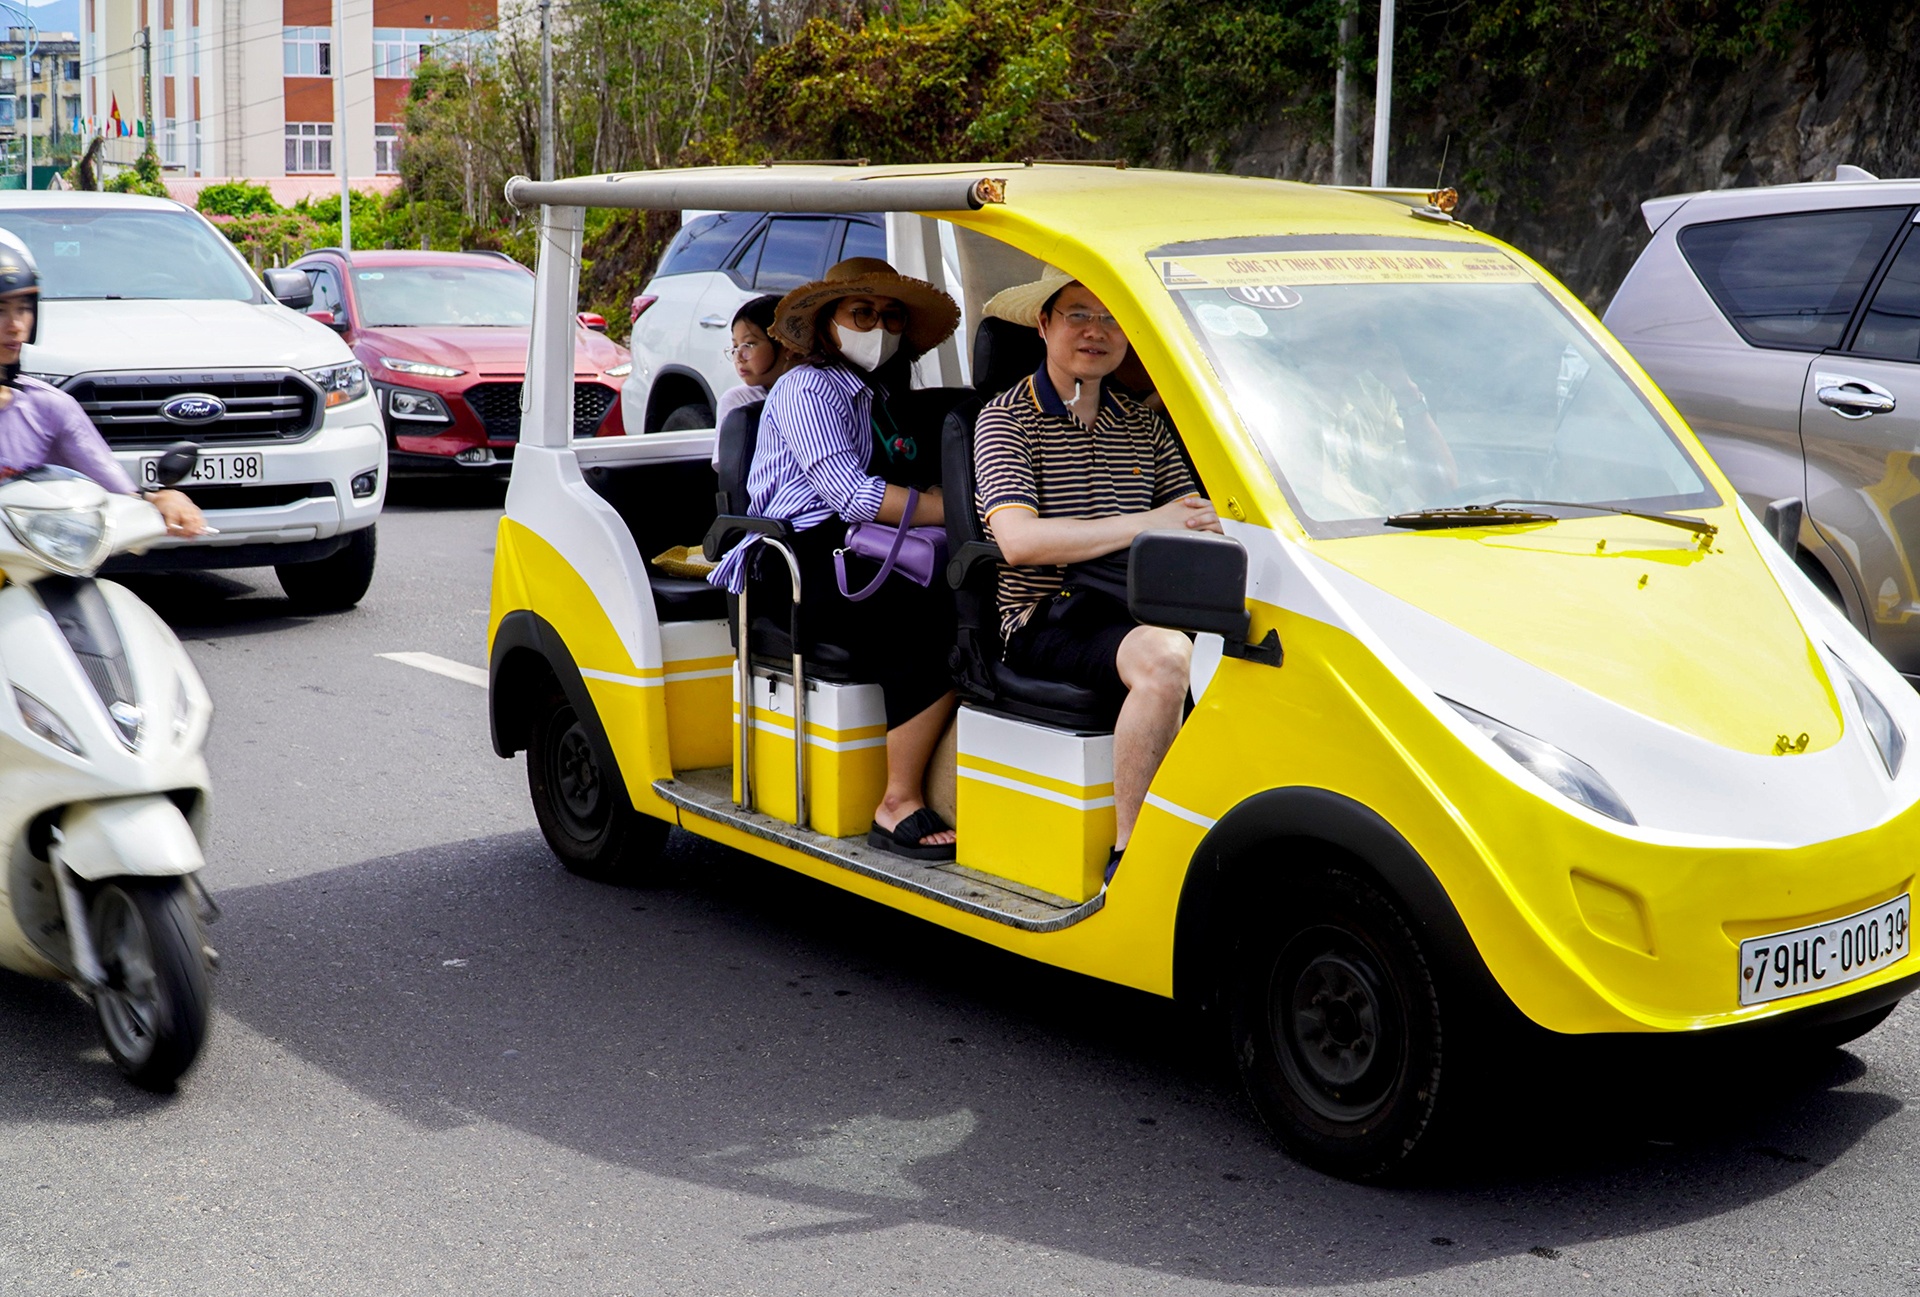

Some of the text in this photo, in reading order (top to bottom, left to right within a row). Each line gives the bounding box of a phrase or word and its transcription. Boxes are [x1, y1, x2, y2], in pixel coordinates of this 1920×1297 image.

[1226, 258, 1267, 274] CÔNG
[1263, 259, 1285, 272] TY
[1282, 258, 1322, 272] TNHH
[1319, 257, 1349, 271] MTV
[1347, 257, 1380, 272] DỊCH
[1396, 257, 1424, 270] SAO
[1240, 285, 1289, 303] 011
[104, 373, 277, 385] RANGER
[178, 401, 210, 416] Ford
[145, 456, 258, 483] 6451.98
[1754, 907, 1904, 993] 79HC-000.39
